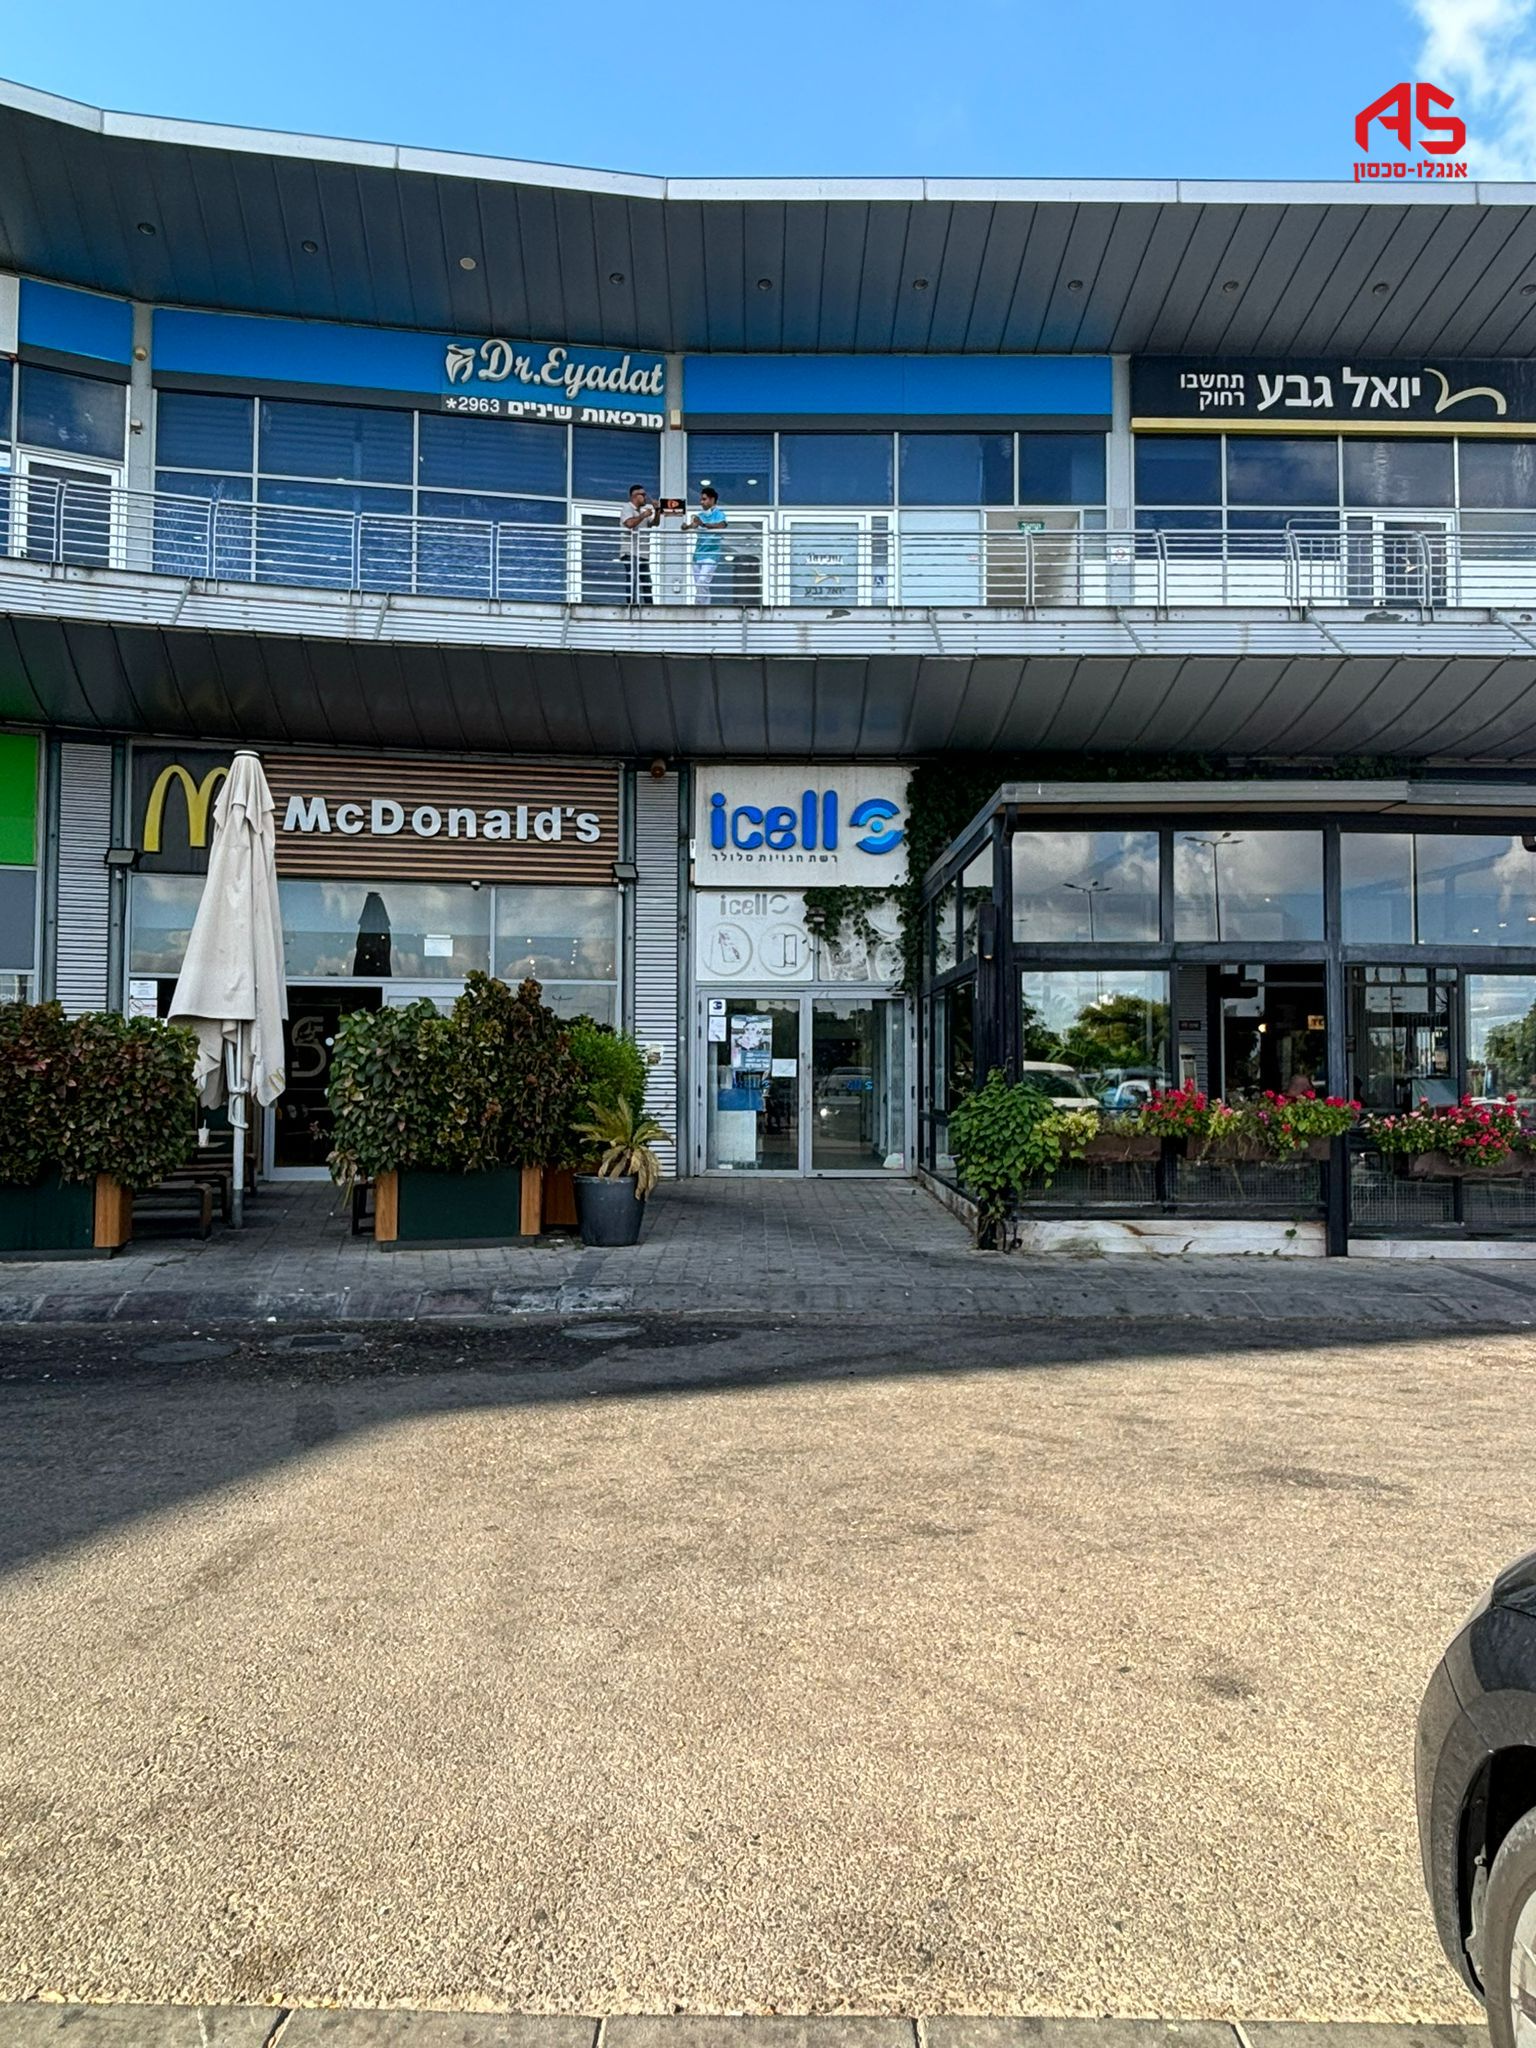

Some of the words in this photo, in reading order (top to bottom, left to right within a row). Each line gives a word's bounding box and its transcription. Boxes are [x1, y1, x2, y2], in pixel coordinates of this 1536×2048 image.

[478, 339, 664, 400] Dr.Eyadat
[1180, 373, 1244, 389] תחשבו
[1342, 367, 1421, 408] יואל
[1200, 391, 1244, 411] רחוק
[1257, 375, 1334, 411] גבע
[508, 400, 572, 420] שיניים
[581, 408, 664, 428] מרפאות
[283, 796, 601, 843] McDonald's
[711, 790, 838, 850] icell
[711, 852, 754, 862] סלולר
[758, 853, 804, 863] חנויות
[808, 854, 838, 863] רשת
[719, 894, 768, 915] icell
